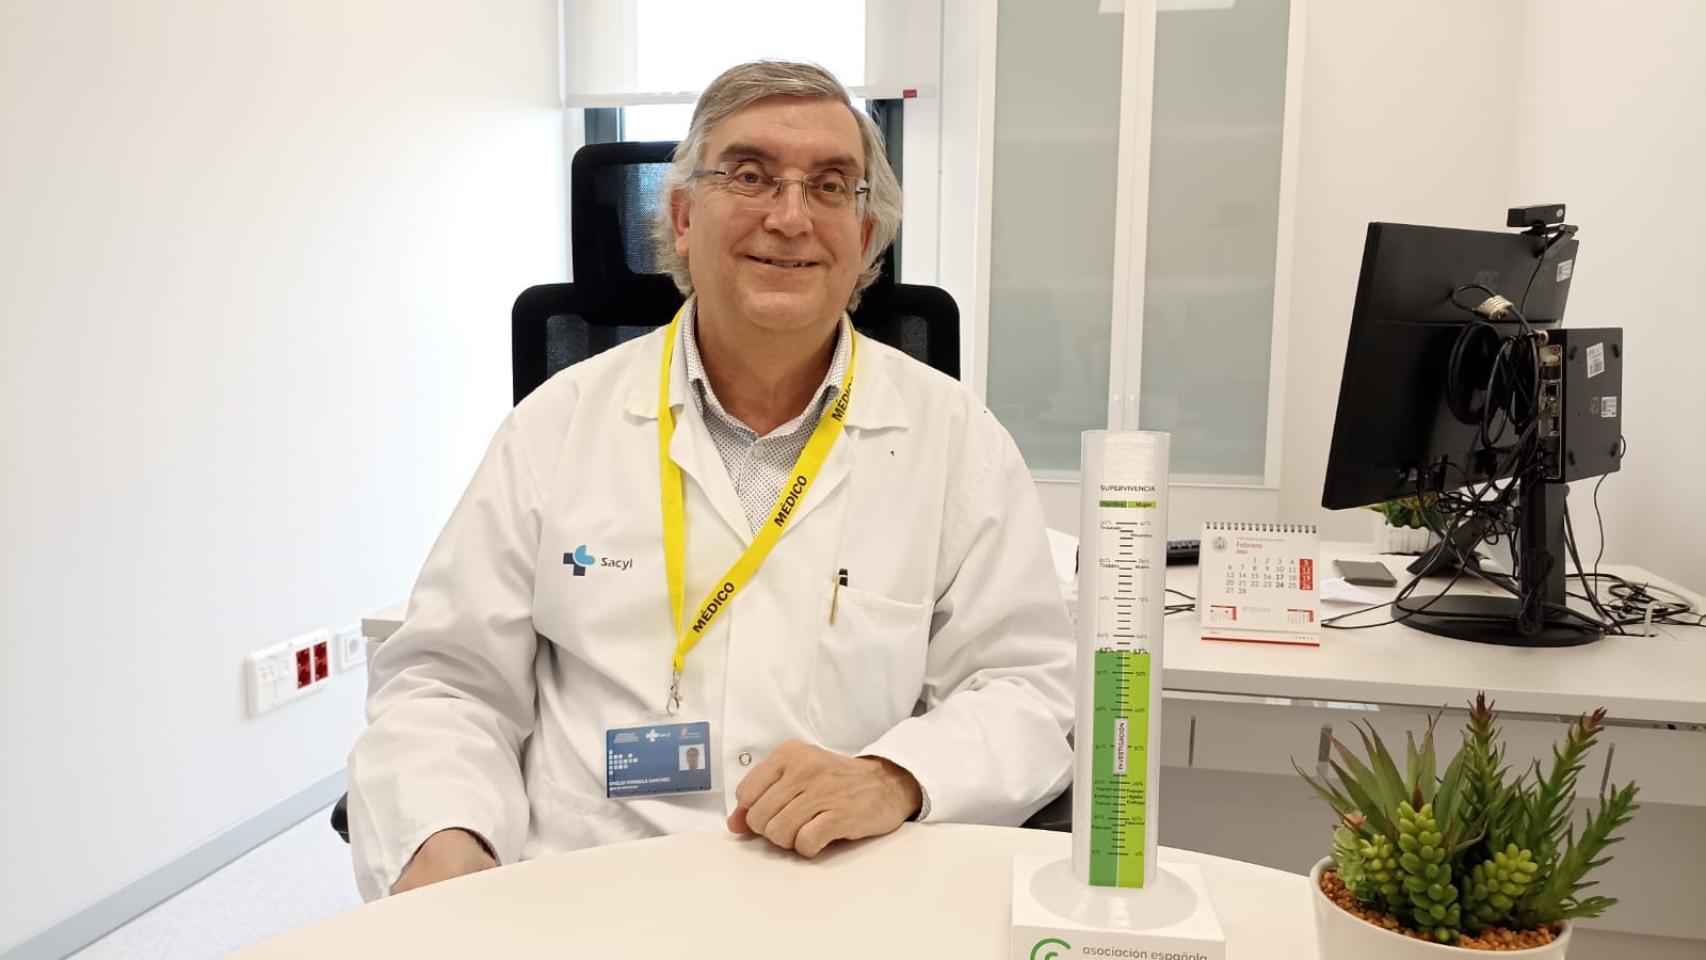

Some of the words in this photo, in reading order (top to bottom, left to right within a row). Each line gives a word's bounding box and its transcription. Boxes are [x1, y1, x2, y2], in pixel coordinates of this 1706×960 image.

[774, 475, 808, 528] MÉDICO
[600, 557, 633, 571] Sacyl
[692, 581, 735, 633] MÉDICO
[1082, 946, 1148, 960] asociación
[1150, 951, 1208, 960] española
